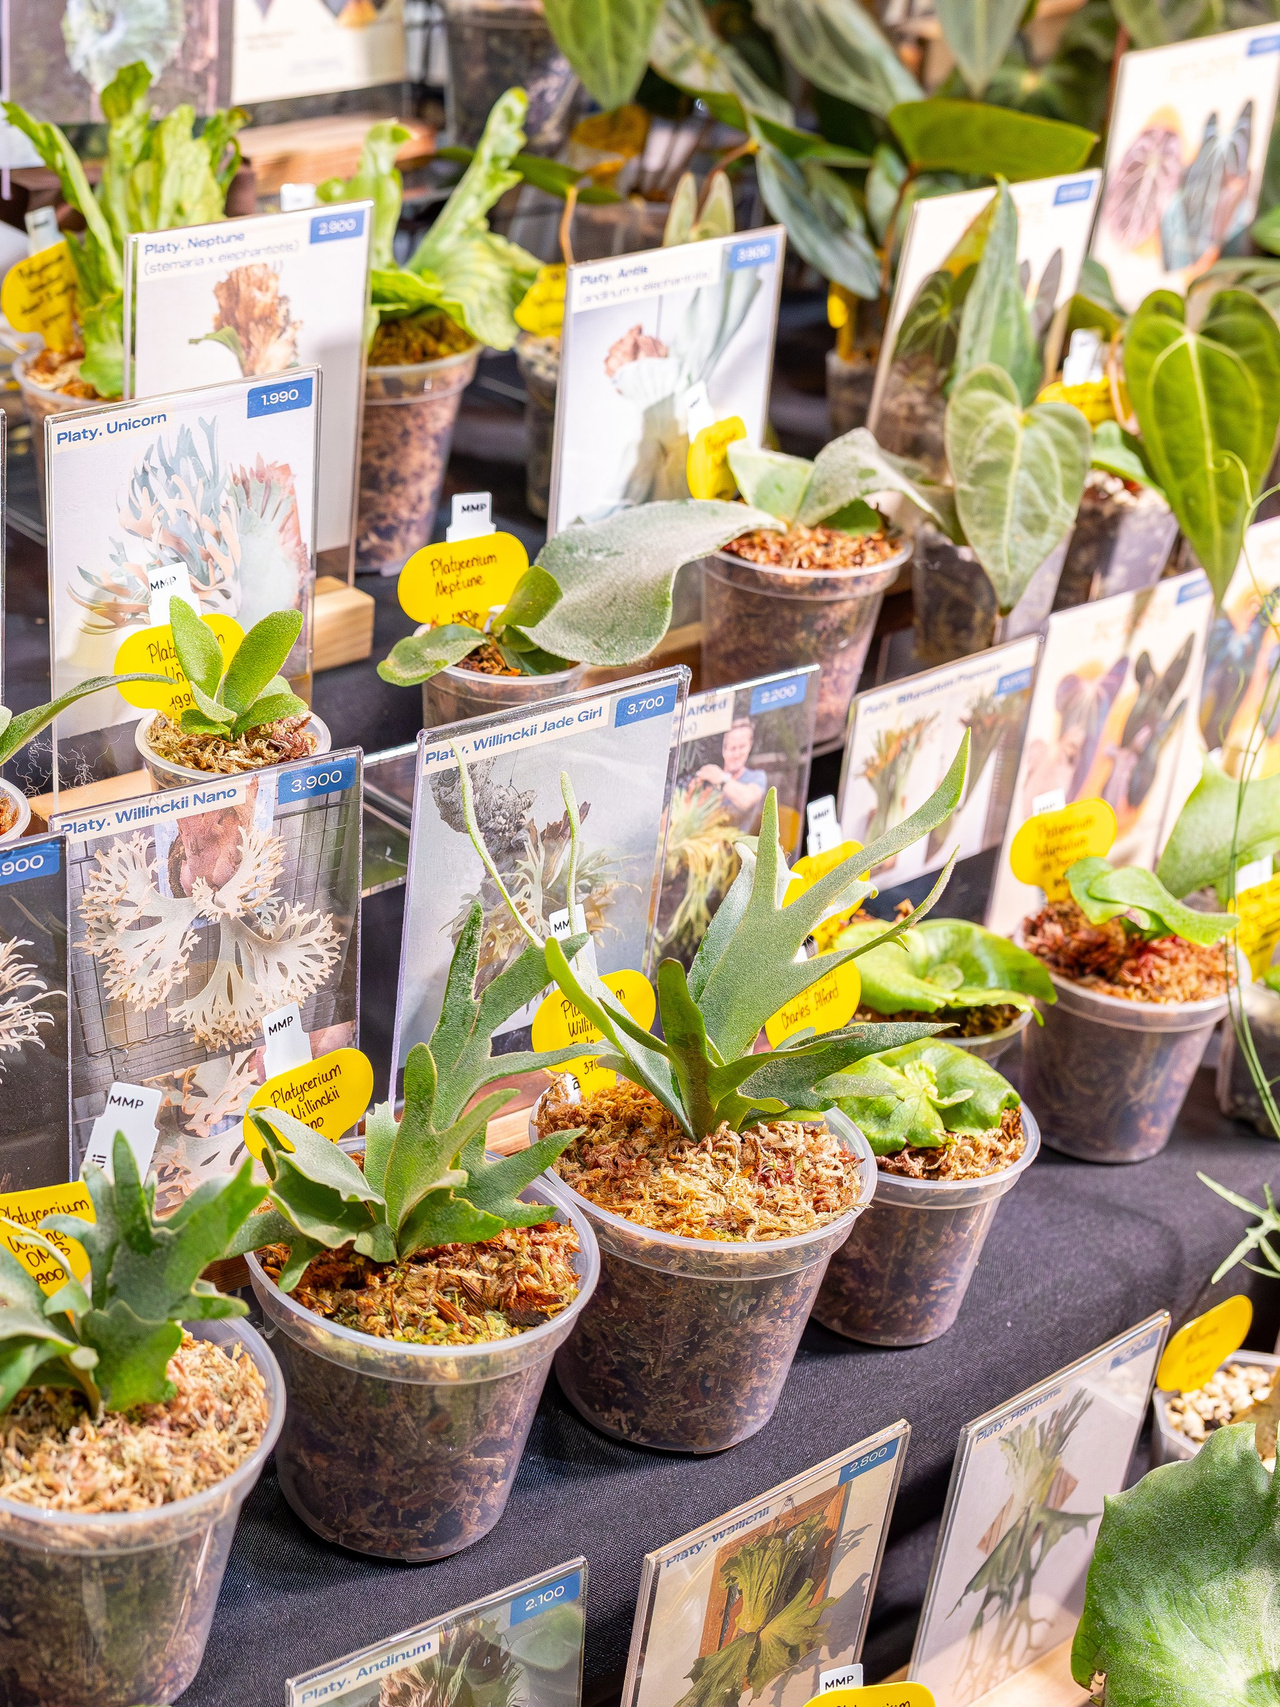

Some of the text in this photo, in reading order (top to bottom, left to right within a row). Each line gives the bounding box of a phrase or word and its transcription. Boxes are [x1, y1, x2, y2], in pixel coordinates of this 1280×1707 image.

[144, 232, 246, 256] Platy. Neptune
[261, 388, 300, 407] 1.990
[56, 413, 167, 445] Platy. Unicorn
[461, 503, 487, 514] MMP
[431, 553, 498, 577] Platycerium
[435, 574, 485, 599] Neptune
[626, 695, 665, 715] 3.700
[687, 698, 727, 717] Alford
[473, 723, 538, 751] Willinckii
[540, 716, 575, 735] Jade
[577, 706, 603, 725] Girl
[290, 770, 343, 793] 3.900
[61, 787, 238, 835] Platy. Willinckii Nano
[554, 919, 570, 932] MM
[781, 1003, 811, 1030] Charles
[814, 980, 839, 1011] Alford
[268, 1016, 294, 1036] MMP
[270, 1064, 342, 1108] Platycerium
[108, 1095, 144, 1110] MMP
[285, 1085, 340, 1120] Willinckii
[849, 1447, 888, 1473] 2.800
[525, 1585, 565, 1612] 2.100
[301, 1640, 432, 1704] Platy. Andinum
[824, 1675, 854, 1690] MMP
